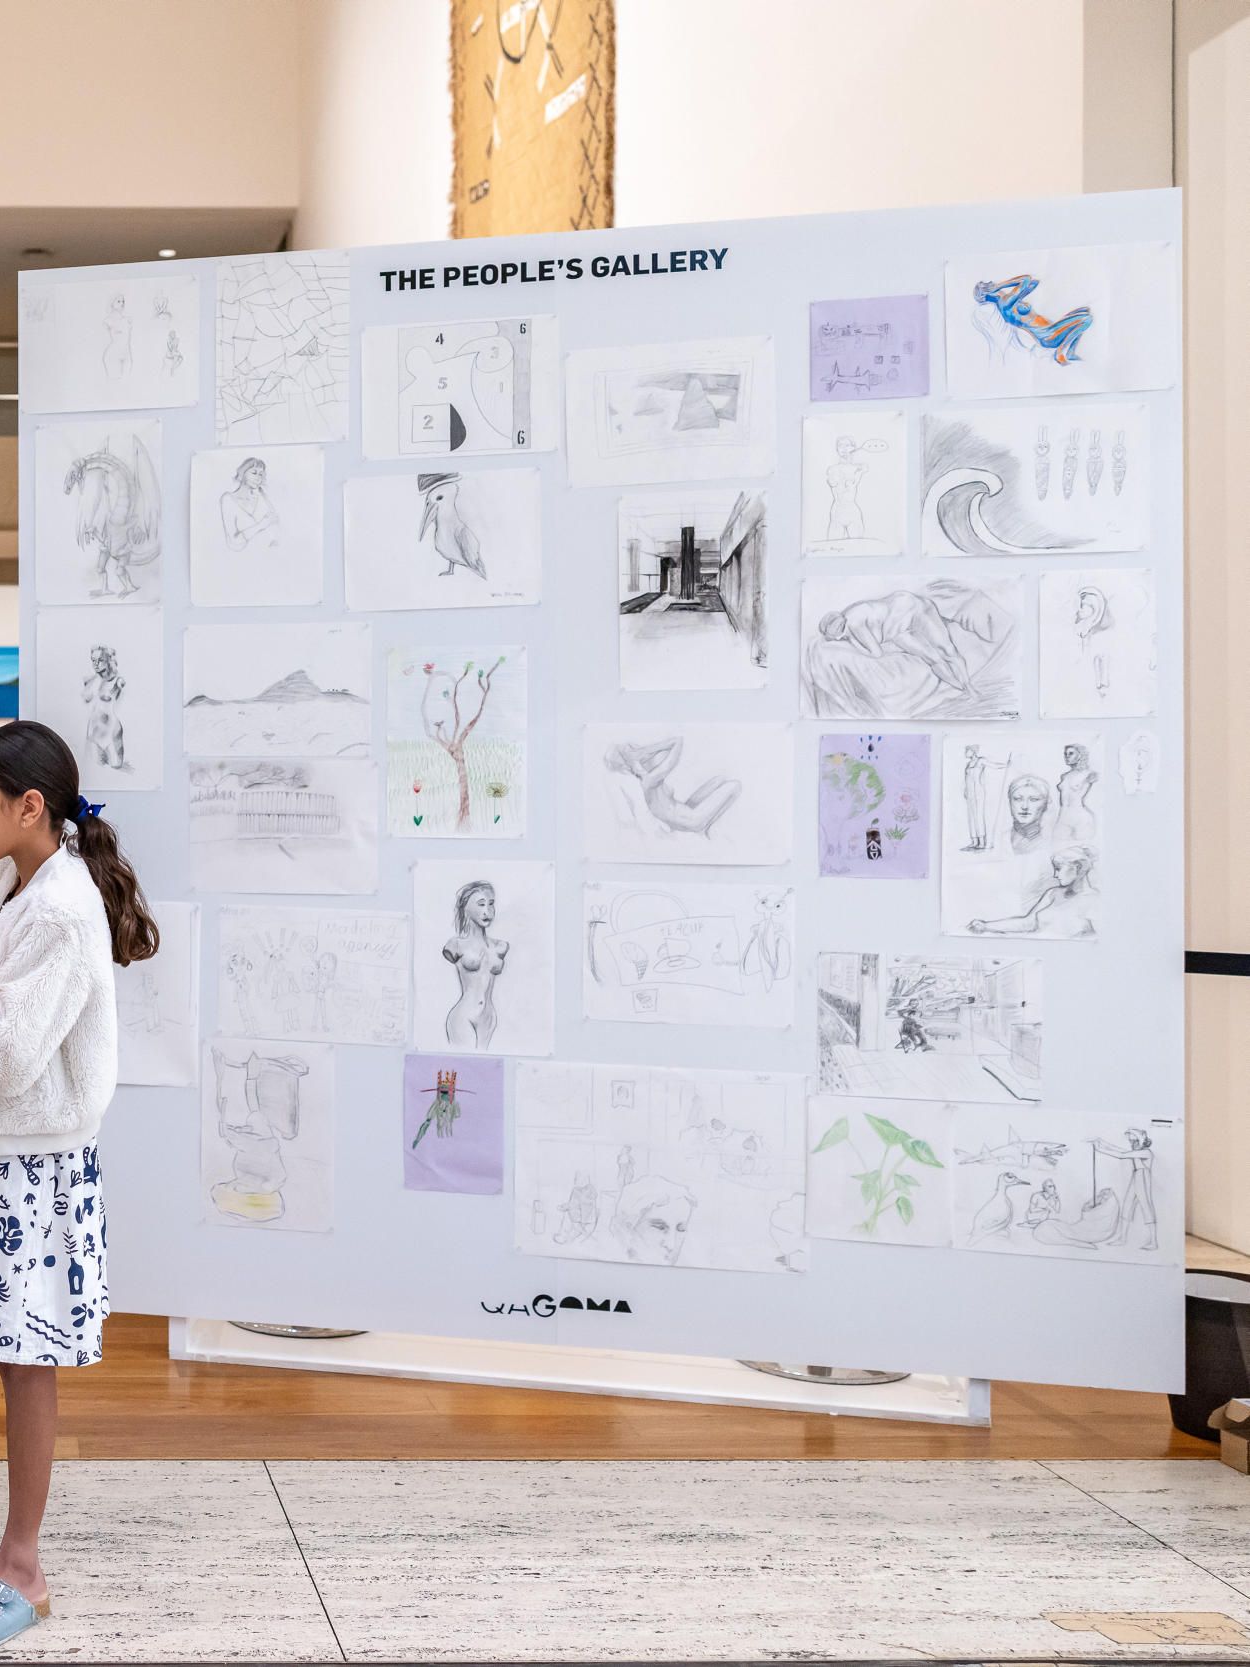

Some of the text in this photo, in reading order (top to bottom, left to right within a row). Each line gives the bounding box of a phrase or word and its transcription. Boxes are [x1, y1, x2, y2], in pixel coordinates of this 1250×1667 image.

[380, 247, 729, 292] THE PEOPLE'S GALLERY
[519, 322, 527, 335] 6
[435, 332, 444, 345] 4
[490, 346, 500, 359] 3
[437, 376, 448, 390] 5
[422, 414, 434, 430] 2
[517, 429, 525, 445] 6
[480, 1293, 633, 1318] QAGOMA
